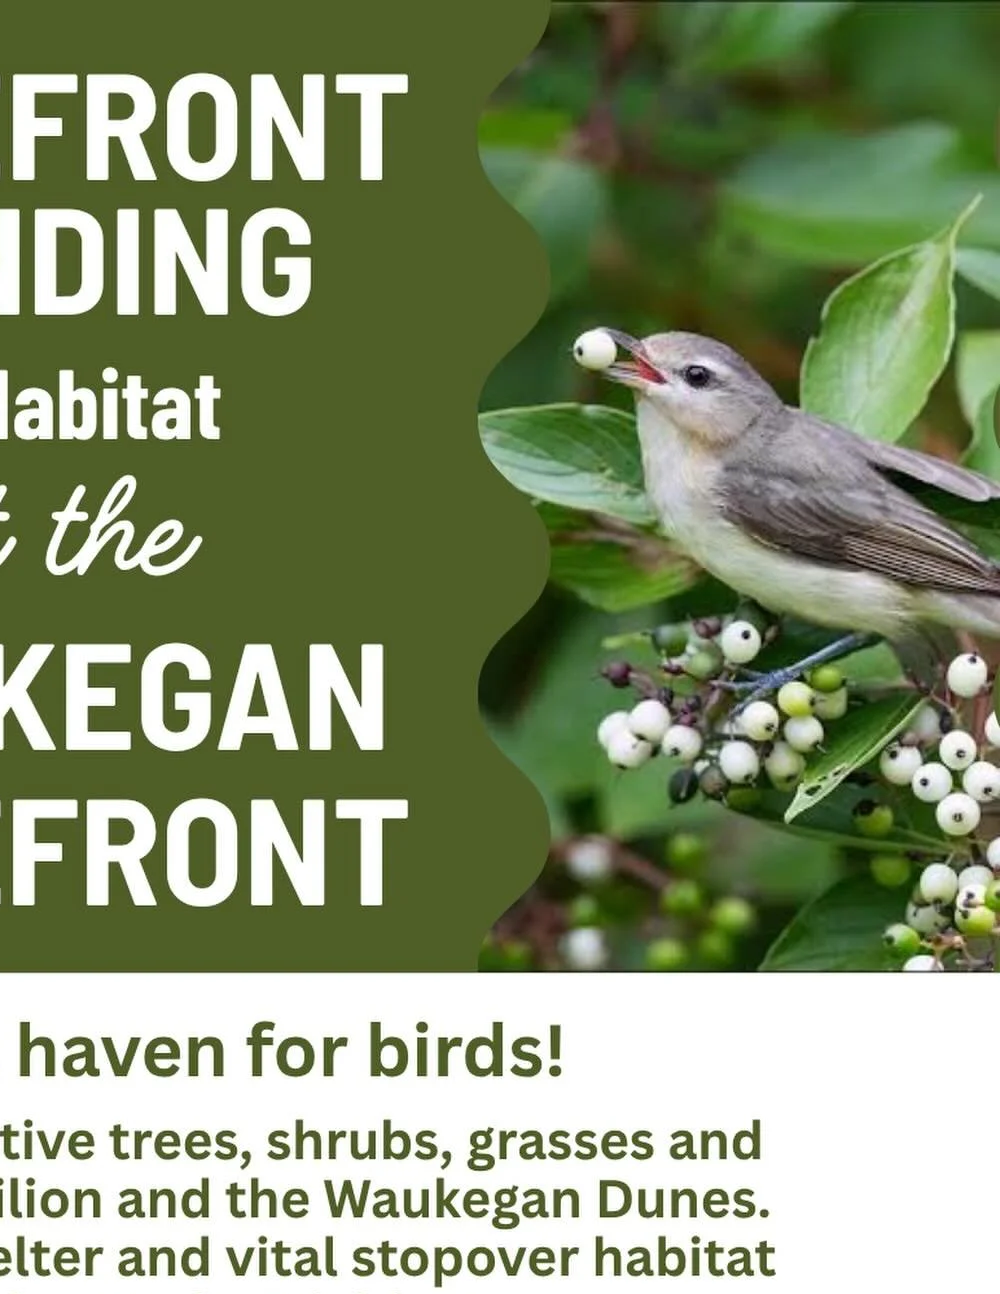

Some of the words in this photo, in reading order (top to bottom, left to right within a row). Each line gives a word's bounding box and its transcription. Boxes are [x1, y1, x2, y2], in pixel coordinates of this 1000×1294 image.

[46, 475, 202, 576] the
[20, 1022, 224, 1077] haven
[246, 1021, 348, 1077] for
[370, 1021, 561, 1077] birds!
[109, 1124, 251, 1172] trees,
[267, 1119, 451, 1172] shrubs,
[467, 1127, 654, 1172] grasses
[670, 1119, 760, 1160] and
[118, 1177, 209, 1218] and
[226, 1177, 309, 1218] the
[324, 1177, 579, 1230] Waukegan
[600, 1180, 769, 1218] Dunes.
[118, 1236, 209, 1277] and
[226, 1236, 337, 1277] vital
[352, 1241, 579, 1288] stopover
[595, 1236, 776, 1277] habitat
